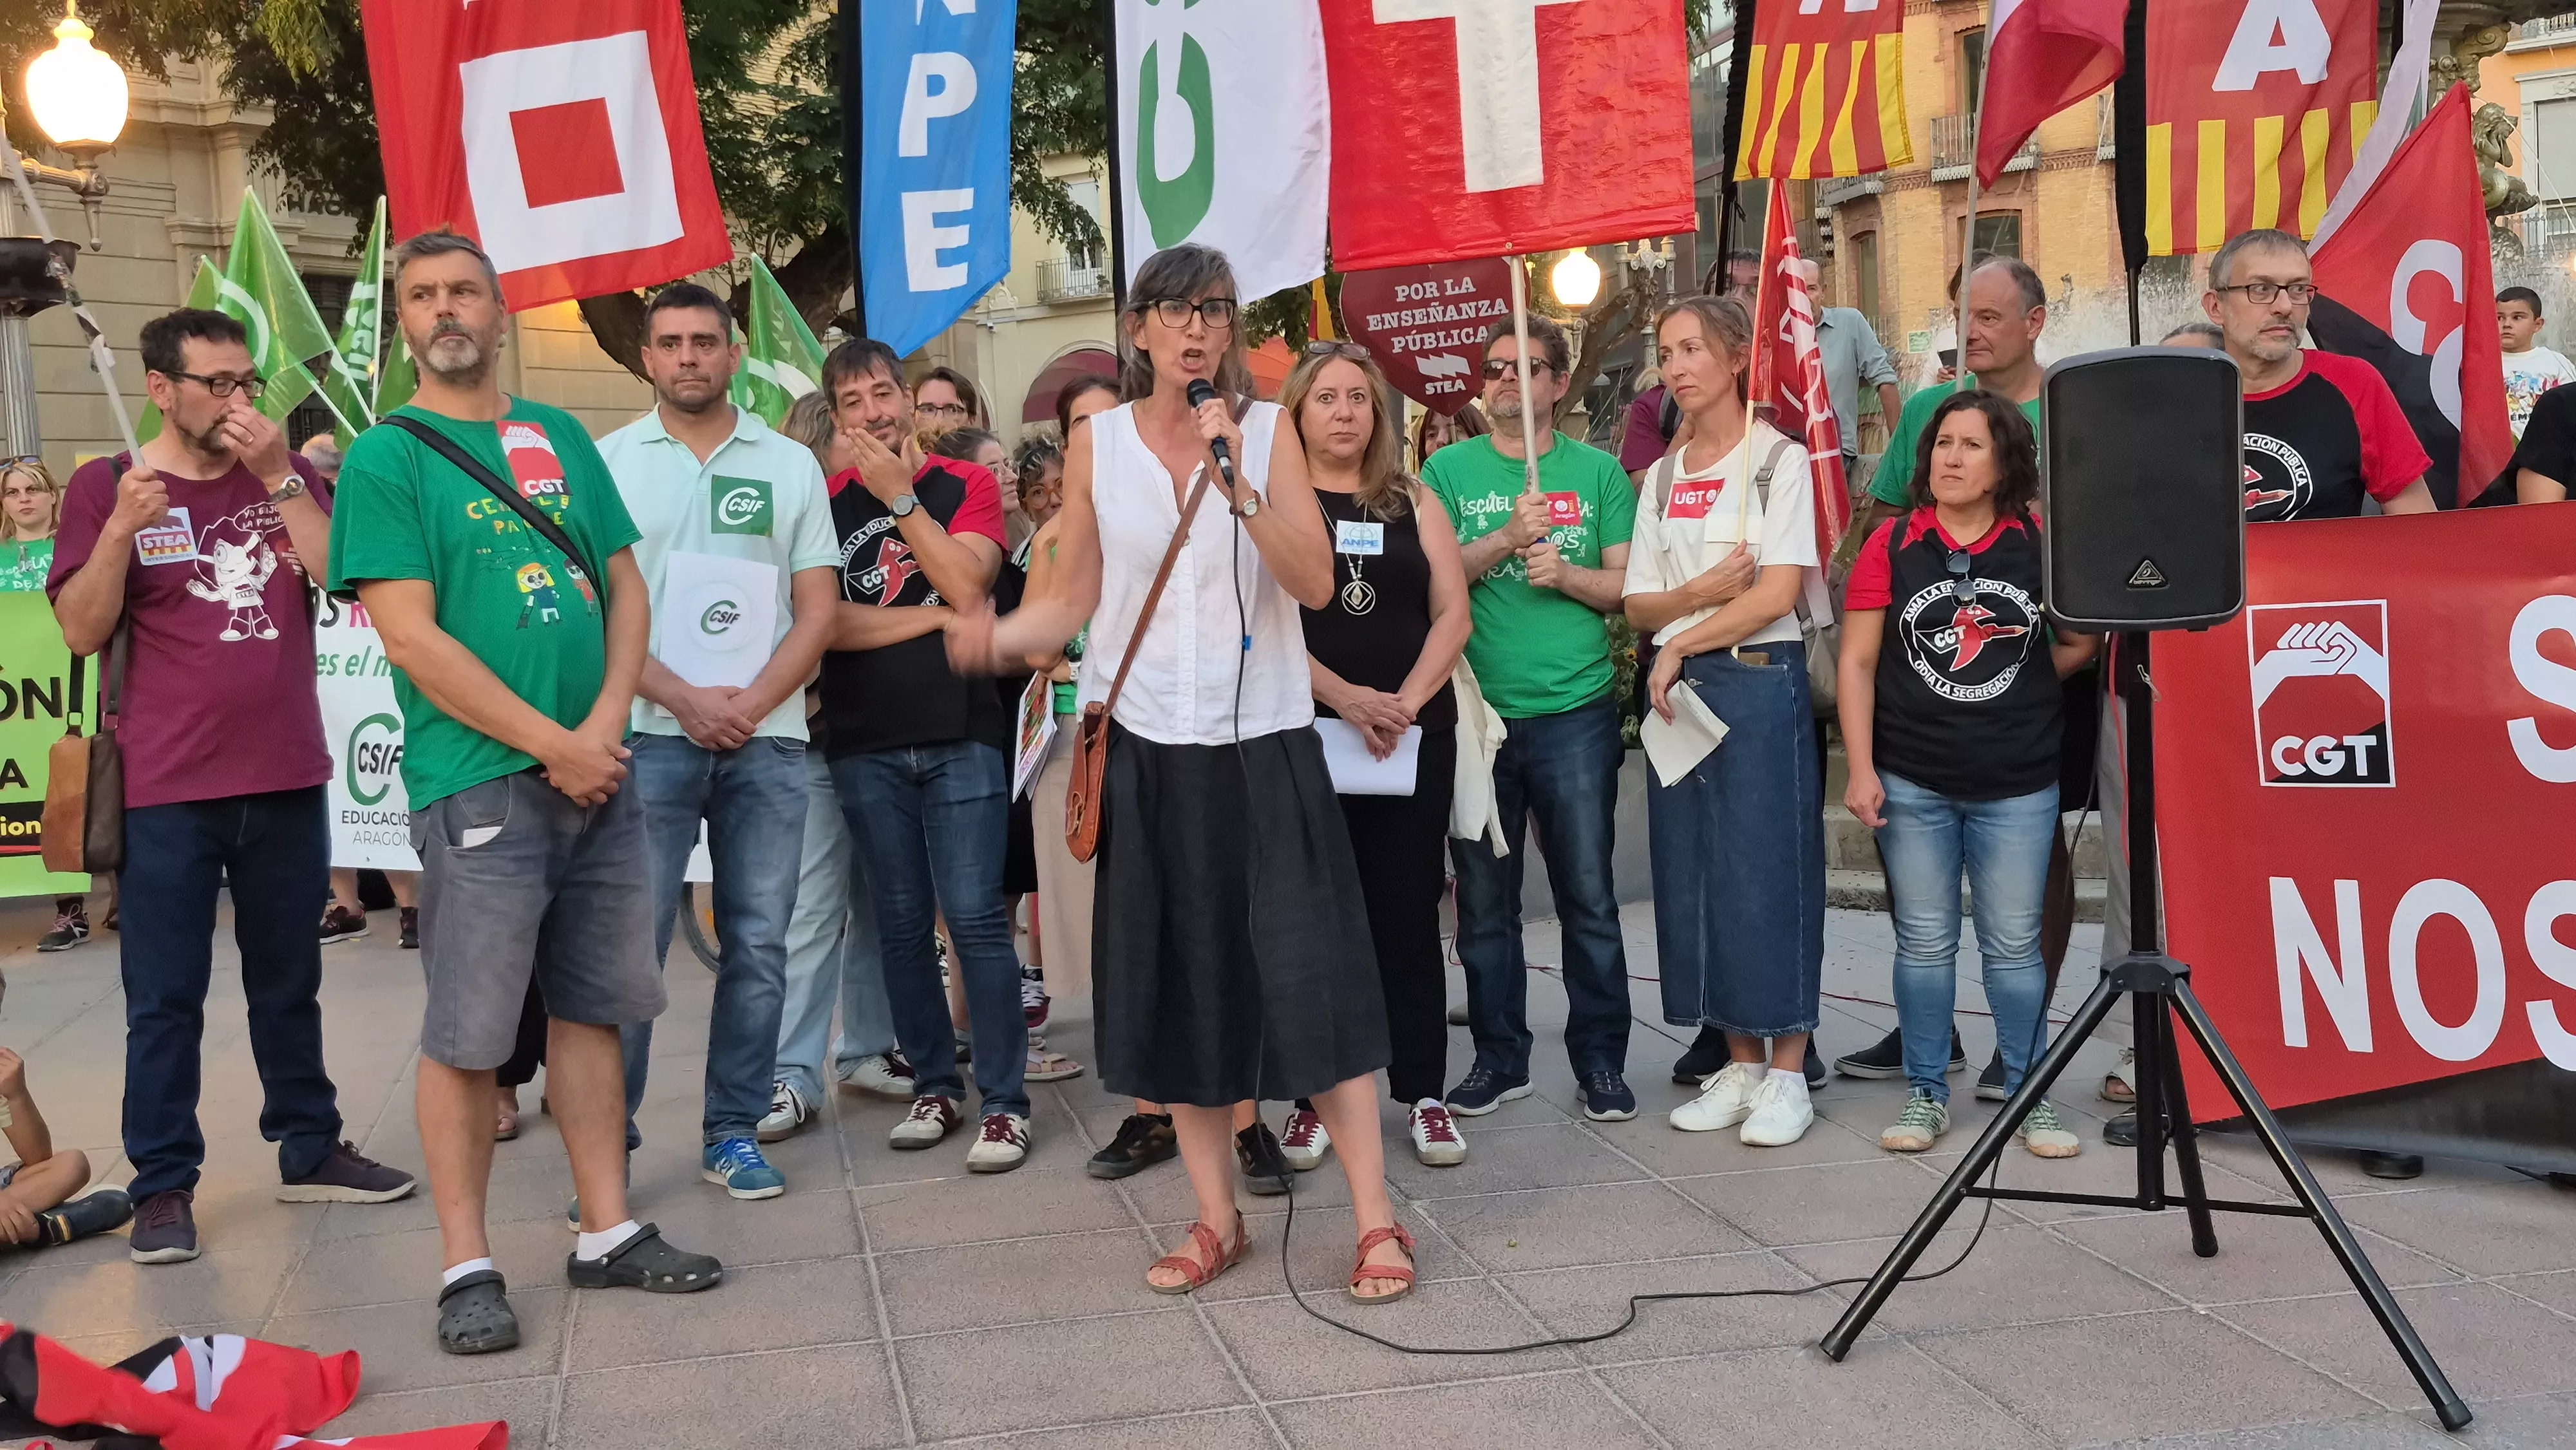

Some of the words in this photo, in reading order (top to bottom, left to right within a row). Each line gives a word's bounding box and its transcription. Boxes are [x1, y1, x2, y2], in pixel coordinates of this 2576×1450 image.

[1394, 281, 1440, 302] POR
[1444, 277, 1477, 296] LA
[1366, 297, 1509, 331] ENSEÑANZA
[1390, 325, 1488, 353] PÚBLICA
[1425, 379, 1467, 395] STEA
[524, 479, 564, 495] CGT
[1675, 491, 1705, 505] UGT
[728, 498, 765, 513] CSIF
[142, 534, 189, 549] STEA
[1342, 538, 1379, 547] ANPE
[862, 565, 889, 588] CGT
[1904, 597, 1926, 622] AMA
[1924, 588, 1941, 600] LA
[709, 610, 741, 625] CSIF
[1934, 625, 1966, 647] CGT
[345, 645, 372, 677] el
[1915, 659, 1936, 686] ODIA
[1935, 680, 1951, 695] LA
[358, 742, 404, 775] CSIF
[2271, 735, 2377, 777] CGT
